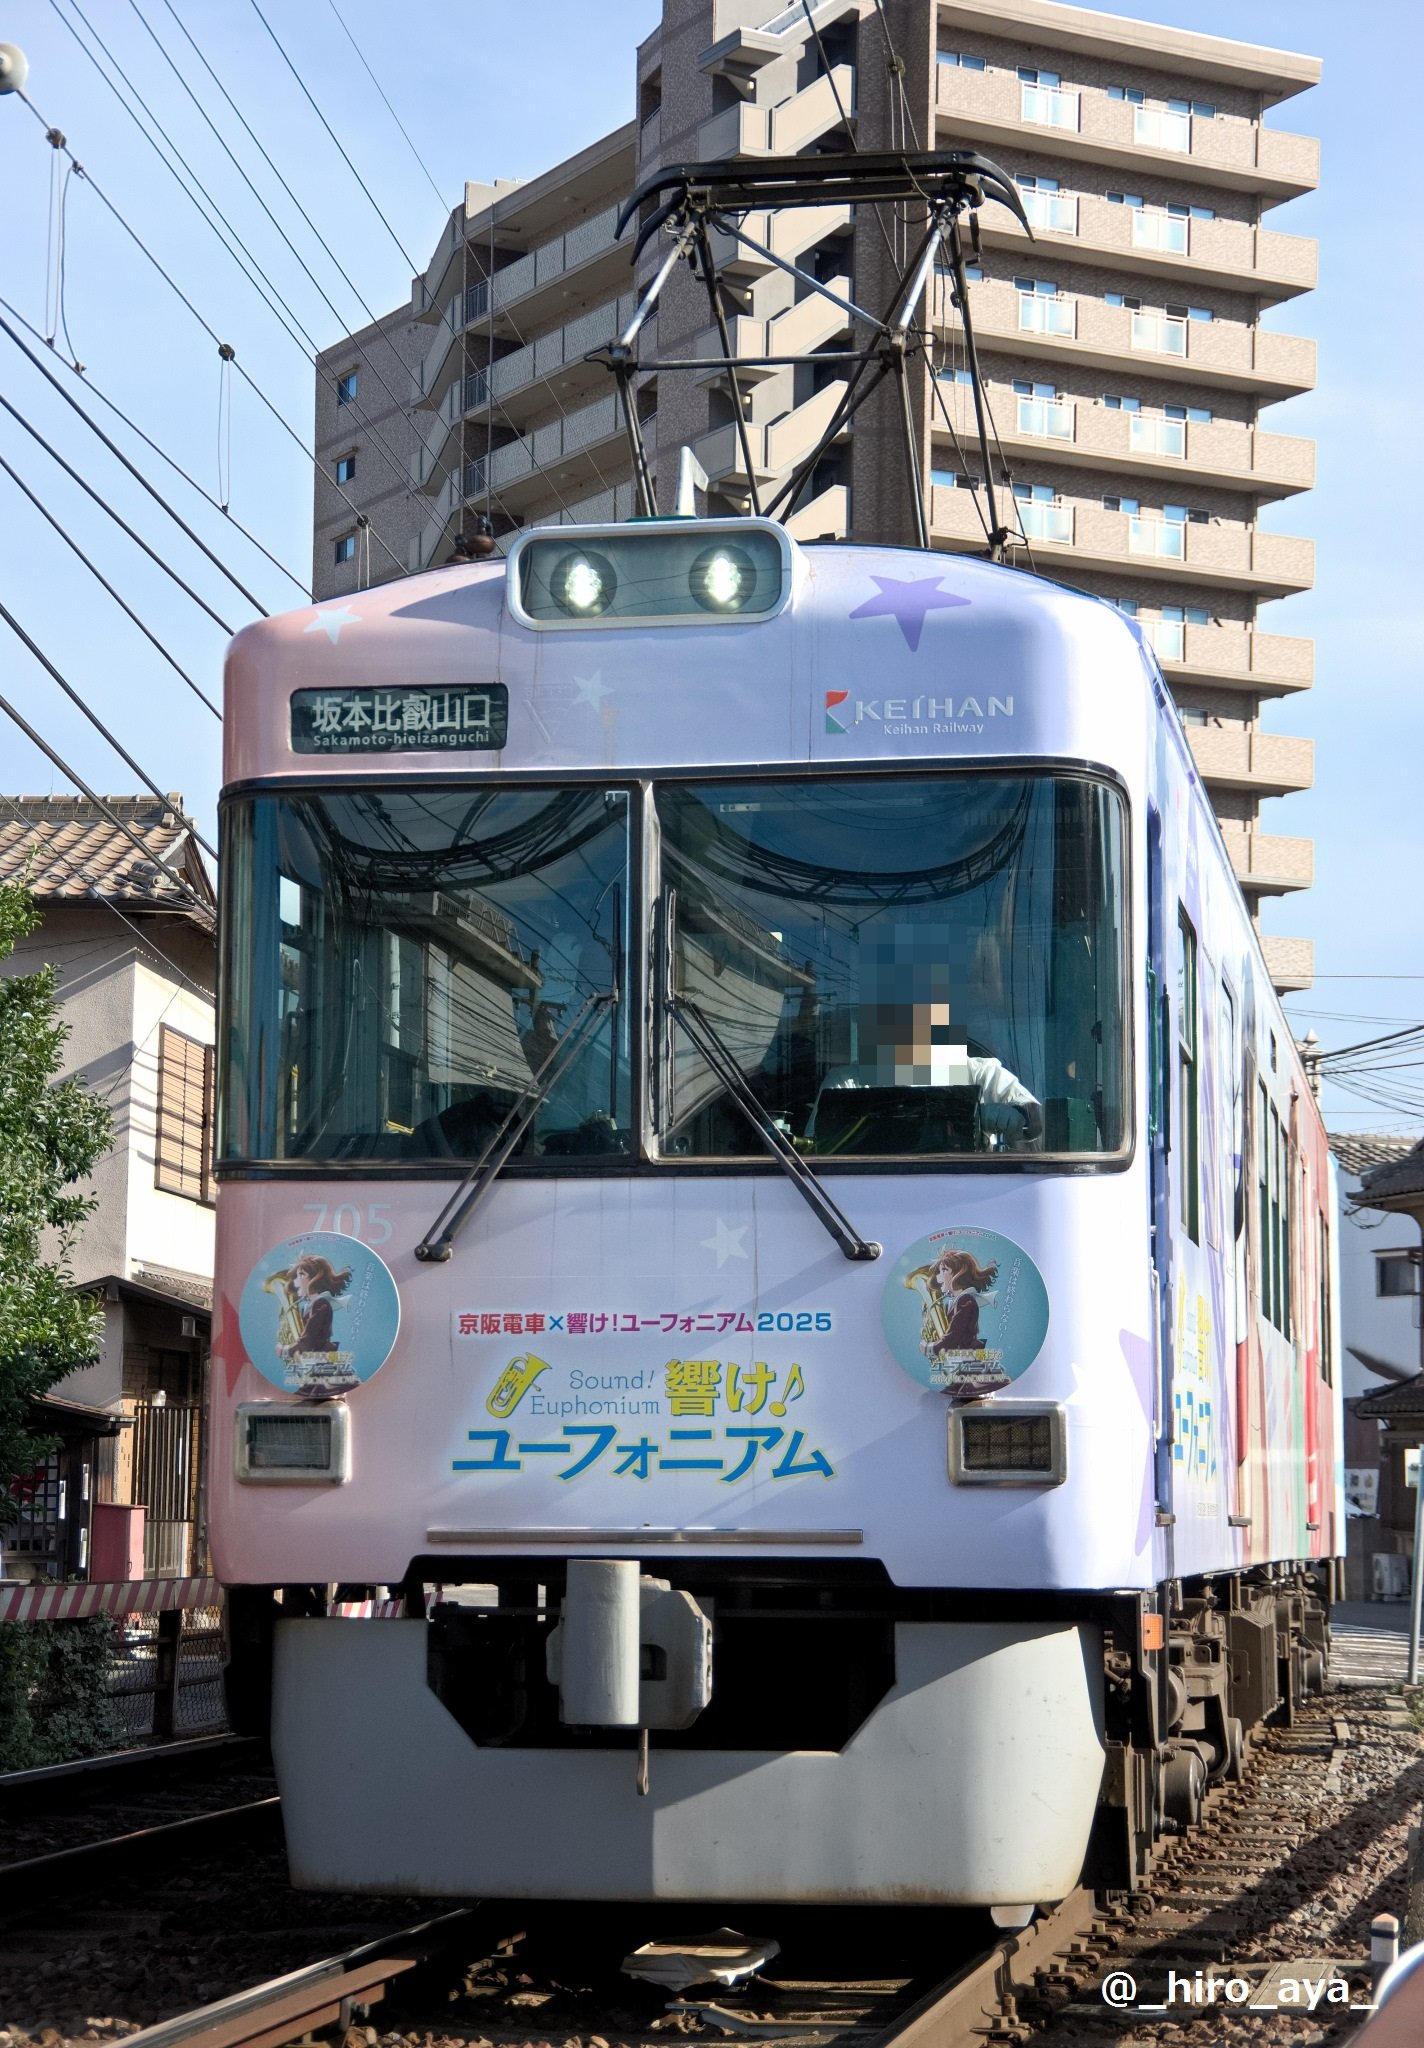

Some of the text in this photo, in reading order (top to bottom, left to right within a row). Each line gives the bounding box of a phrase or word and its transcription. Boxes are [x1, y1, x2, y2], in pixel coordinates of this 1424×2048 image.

[312, 693, 490, 732] 坂本比叡山口
[855, 695, 1014, 721] KEIHAN
[313, 731, 490, 747] Sakamoto-hieizanguchi
[883, 722, 984, 735] Keihan Railway
[303, 1203, 393, 1245] 705
[569, 1369, 655, 1390] Sound!
[530, 1396, 660, 1418] Euphonium
[451, 1423, 837, 1484] ユーフォニアム
